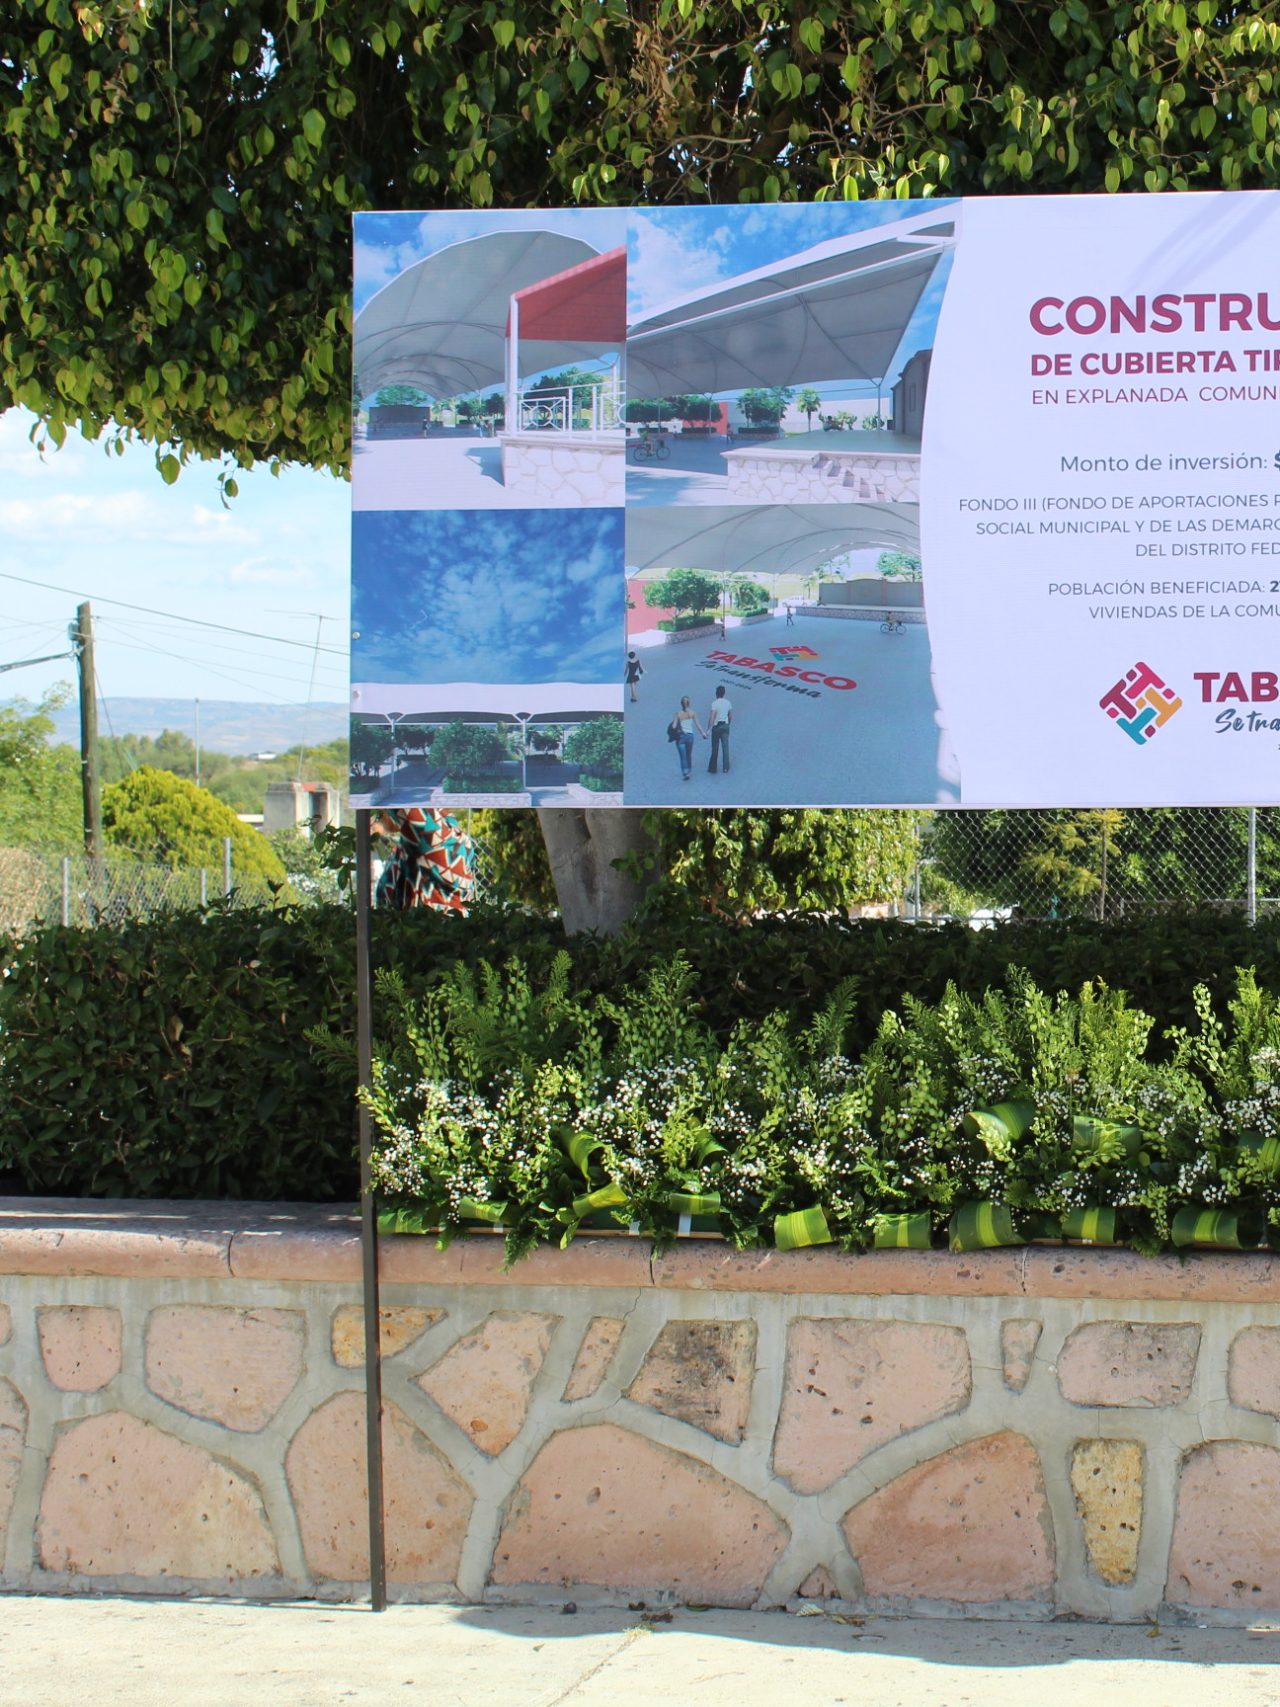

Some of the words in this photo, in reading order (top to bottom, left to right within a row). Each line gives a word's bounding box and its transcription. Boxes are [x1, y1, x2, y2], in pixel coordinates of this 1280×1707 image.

[1031, 354, 1072, 376] DE
[1080, 350, 1237, 375] CUBIERTA
[1033, 390, 1058, 404] EN
[1066, 387, 1188, 404] EXPLANADA
[1061, 456, 1129, 472] Monto
[1135, 454, 1162, 471] de
[1169, 452, 1267, 470] inversión:
[960, 499, 1018, 511] FONDO
[1024, 498, 1036, 510] III
[1042, 497, 1106, 511] (FONDO
[1112, 497, 1133, 509] DE
[1139, 495, 1268, 508] APORTACIONES
[976, 522, 1034, 535] SOCIAL
[1040, 521, 1130, 534] MUNICIPAL
[1135, 521, 1144, 532] Y
[1150, 520, 1171, 532] DE
[1178, 519, 1206, 532] LAS
[1136, 544, 1166, 556] DEL
[1172, 543, 1246, 556] DISTRITO
[1049, 579, 1144, 595] POBLACIÓN
[1151, 581, 1265, 594] BENEFICIADA:
[1089, 606, 1177, 619] VIVIENDAS
[1183, 605, 1205, 618] DE
[1211, 605, 1230, 617] LA
[706, 650, 858, 690] TABASCO
